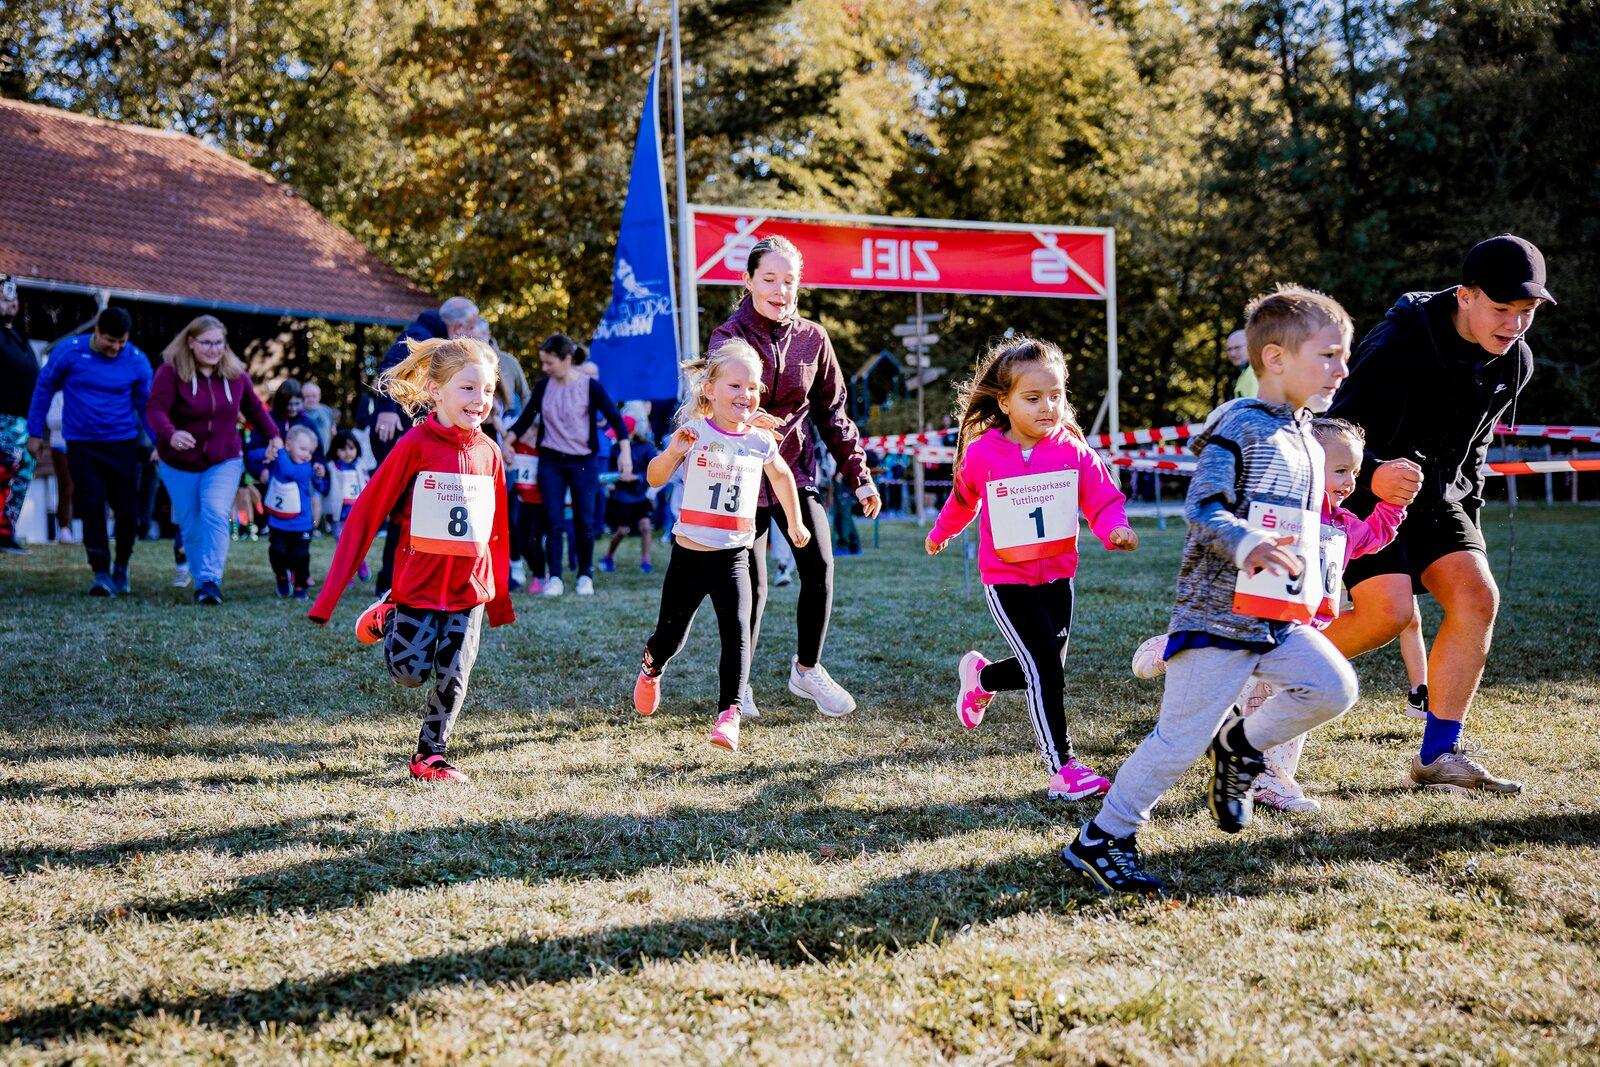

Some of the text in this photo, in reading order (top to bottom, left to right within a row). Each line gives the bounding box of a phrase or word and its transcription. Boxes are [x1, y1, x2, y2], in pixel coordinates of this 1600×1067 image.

[707, 470, 742, 482] Tuttlinen
[1010, 480, 1071, 495] Kreissparkasse
[708, 482, 740, 513] 13
[1011, 494, 1055, 506] Tuttlingen
[447, 506, 469, 537] 8
[1029, 506, 1045, 539] 1
